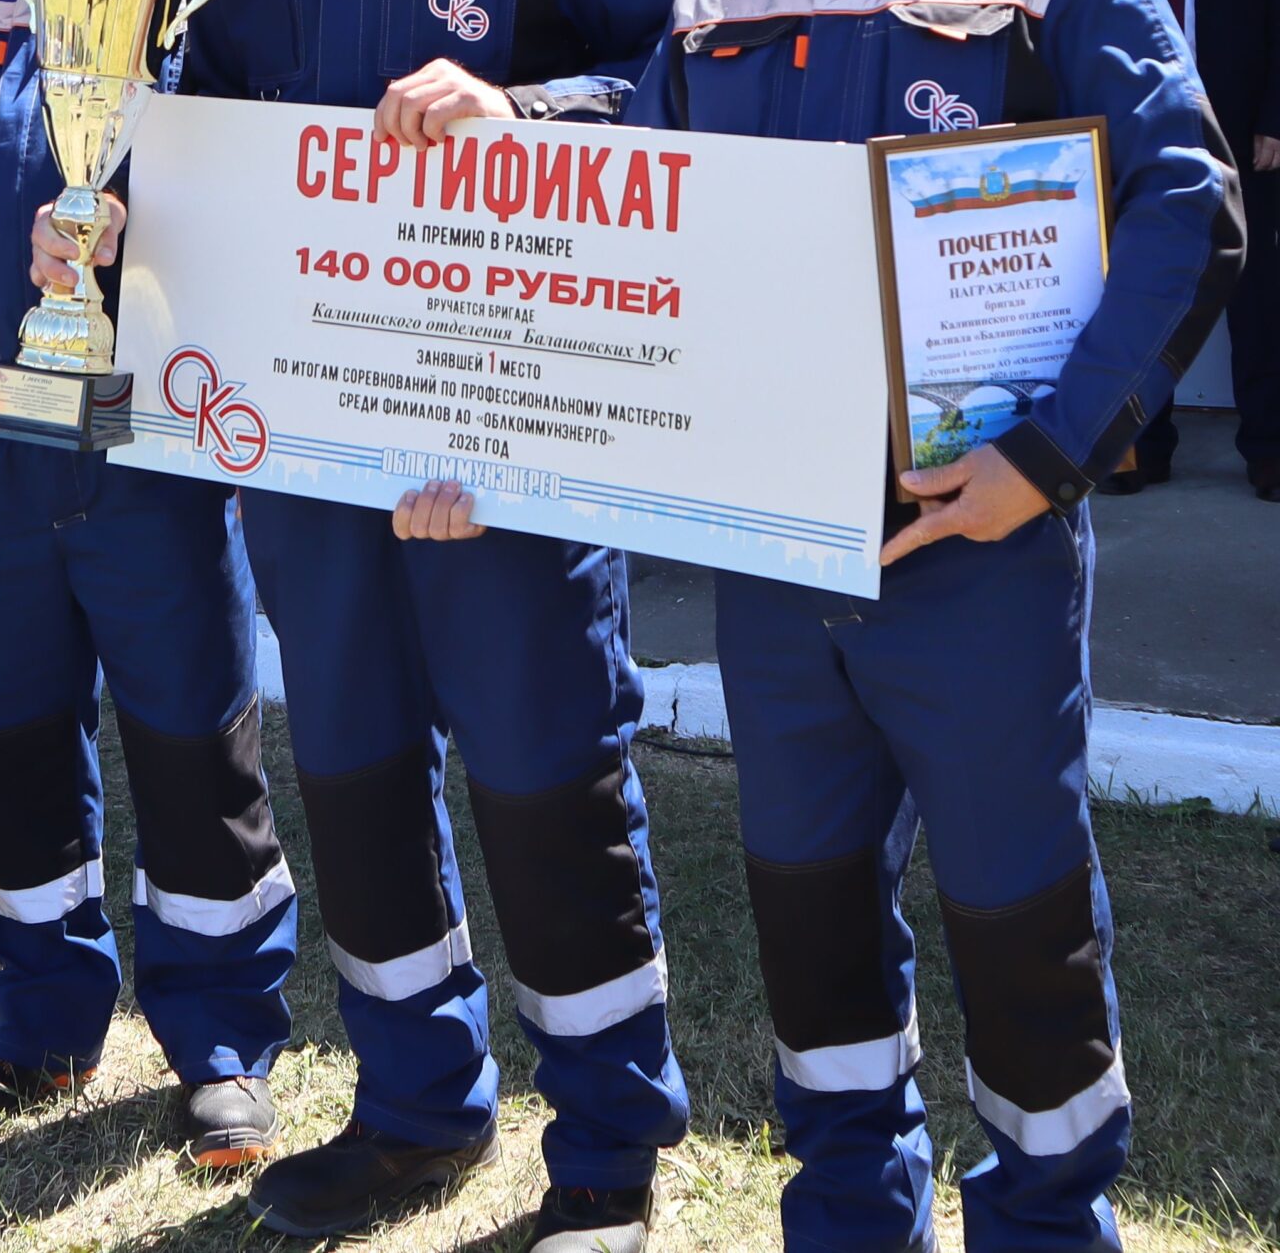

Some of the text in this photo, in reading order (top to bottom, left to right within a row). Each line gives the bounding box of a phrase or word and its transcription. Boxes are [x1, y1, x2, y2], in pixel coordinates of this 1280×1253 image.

[296, 124, 691, 232] СЕРТИФИКАТ
[398, 222, 573, 258] НА ПРЕМИЮ В РАЗМЕРЕ
[938, 226, 1058, 257] ПОЧЕТНАЯ
[296, 247, 680, 318] 140 000 РУБЛЕЙ
[949, 252, 1052, 280] ГРАМОТА
[949, 276, 1061, 299] НАГРАЖДАЕТСЯ
[426, 297, 535, 323] ВРУЧАЕТСЯ БРИГАДЕ
[312, 301, 681, 365] Калининского отделения Балашовских МЭС
[417, 349, 541, 380] ЗАНЯВШЕЙ 1 МЕСТО
[158, 345, 271, 478] ОКЭ
[273, 358, 692, 431] ПО ИТОГАМ СОРЕВНОВАНИЙ ПО ПРОФЕССИОНАЛЬНОМУ МАСТЕРСТВУ
[339, 392, 615, 446] СРЕДИ ФИЛИАЛОВ АО «ОБЛКОММУНЭНЕРГО»
[448, 433, 509, 459] 2026 ГОД
[382, 447, 562, 501] ОБЛКОММУНЭНЕРГО
